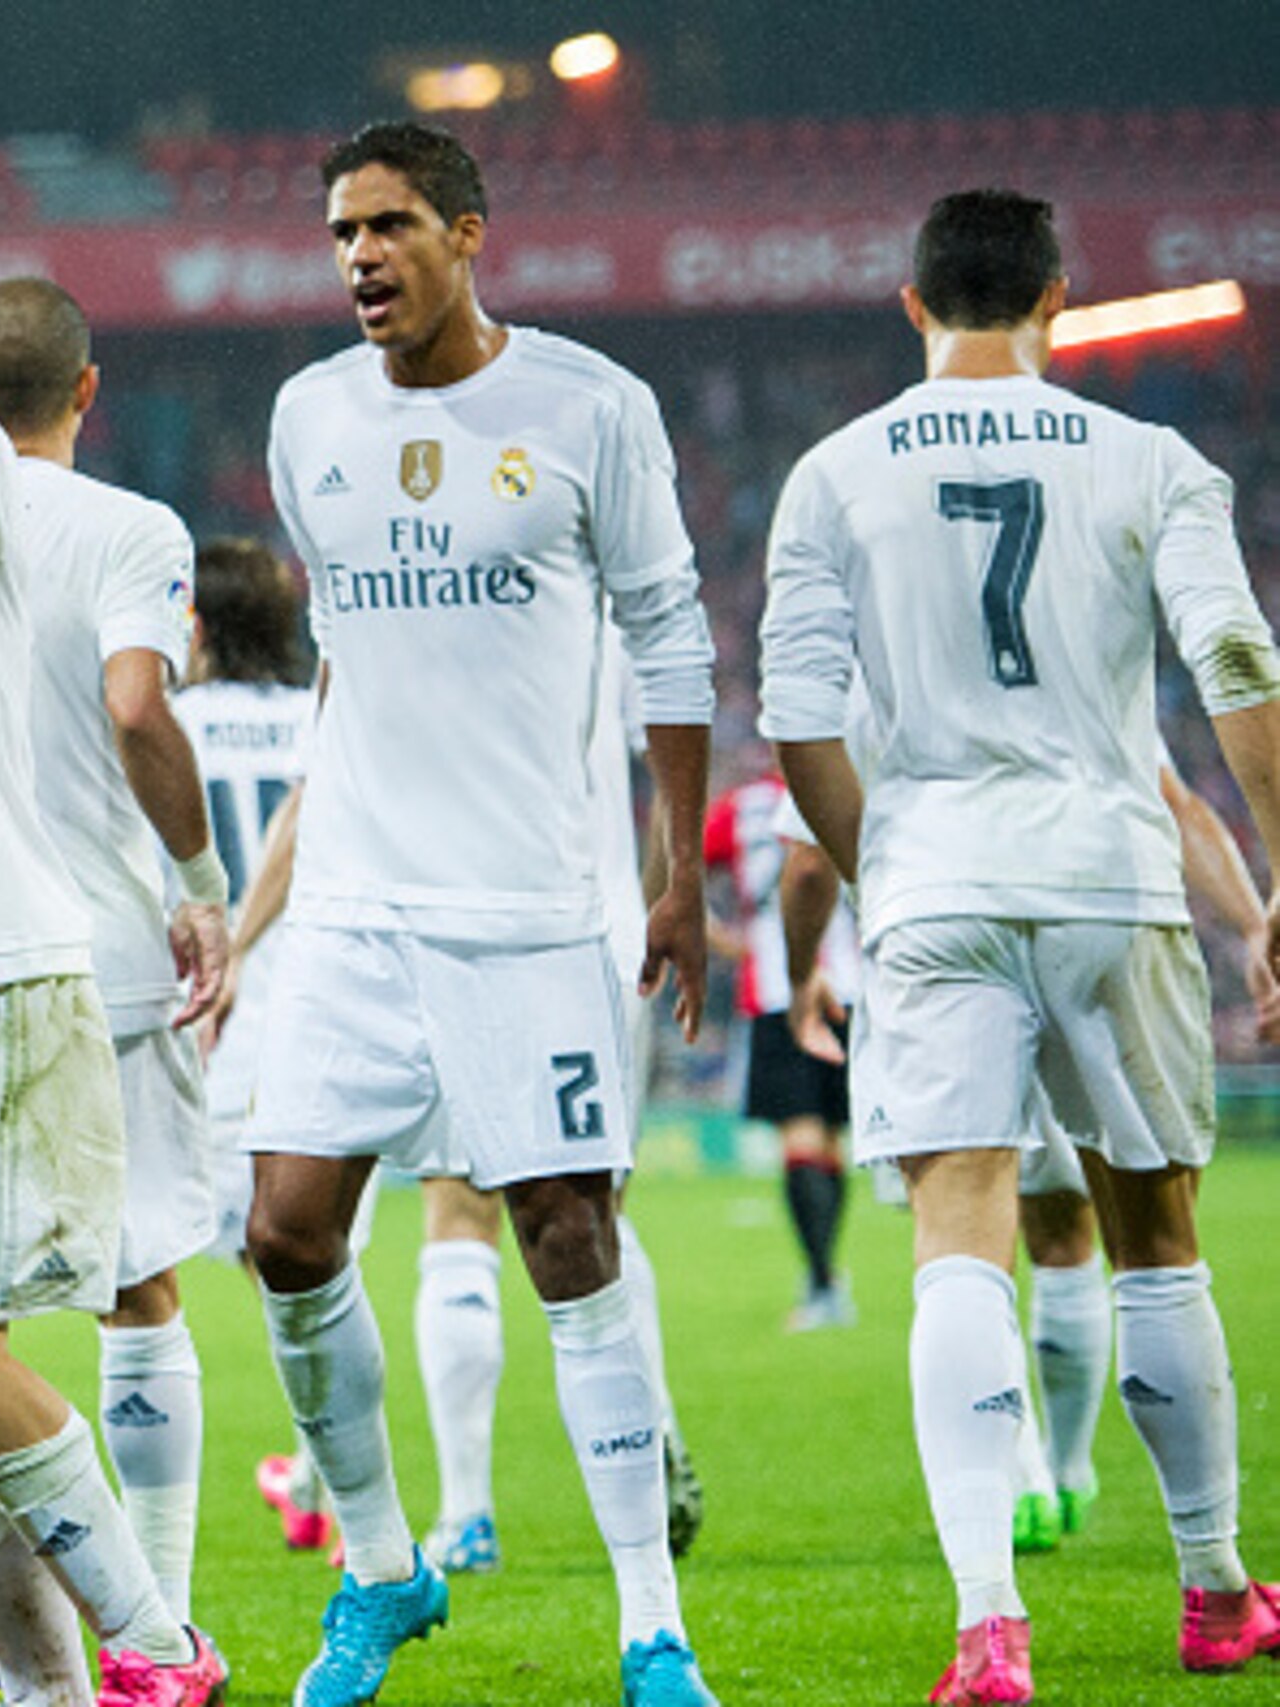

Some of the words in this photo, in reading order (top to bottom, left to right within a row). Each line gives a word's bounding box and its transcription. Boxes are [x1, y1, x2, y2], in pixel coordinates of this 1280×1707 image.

[886, 407, 1088, 456] RONALDO
[388, 516, 452, 558] Fly
[326, 554, 537, 613] Emirates
[932, 472, 1046, 690] 7
[550, 1050, 606, 1142] 2
